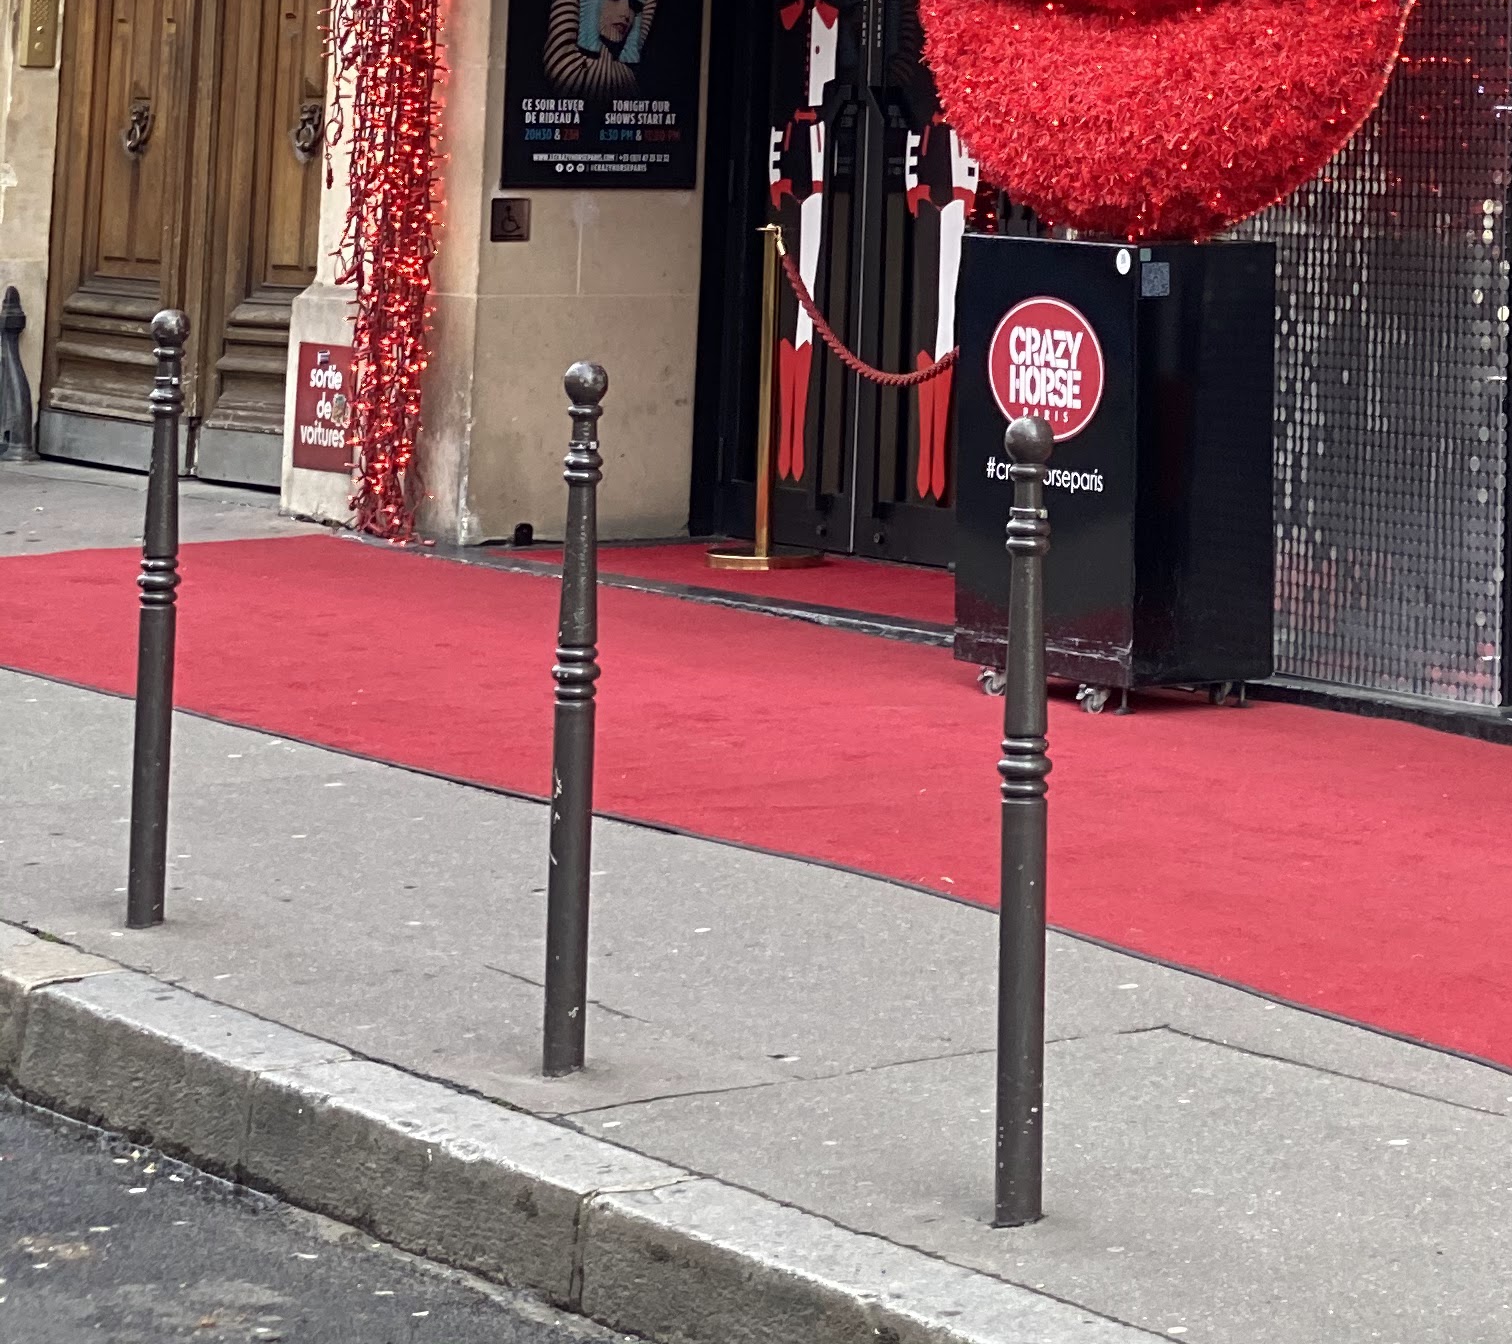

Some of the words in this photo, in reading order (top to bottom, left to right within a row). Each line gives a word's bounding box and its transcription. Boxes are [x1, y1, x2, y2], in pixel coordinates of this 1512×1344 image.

[522, 98, 532, 111] CE
[535, 99, 555, 111] SOIR
[558, 99, 584, 111] LEVER
[612, 100, 650, 112] TONIGHT
[652, 100, 670, 112] OUR
[525, 112, 536, 124] DE
[539, 112, 572, 124] RIDEAU
[605, 113, 636, 125] SHOWS
[637, 113, 663, 125] START
[665, 113, 676, 125] AT
[554, 128, 561, 141] &
[635, 129, 642, 141] &
[1009, 325, 1084, 369] CRAZY
[309, 364, 343, 390] sortie
[1009, 365, 1082, 409] HORSE
[316, 391, 332, 419] de
[1022, 406, 1069, 423] PARIS
[300, 419, 345, 448] voitures
